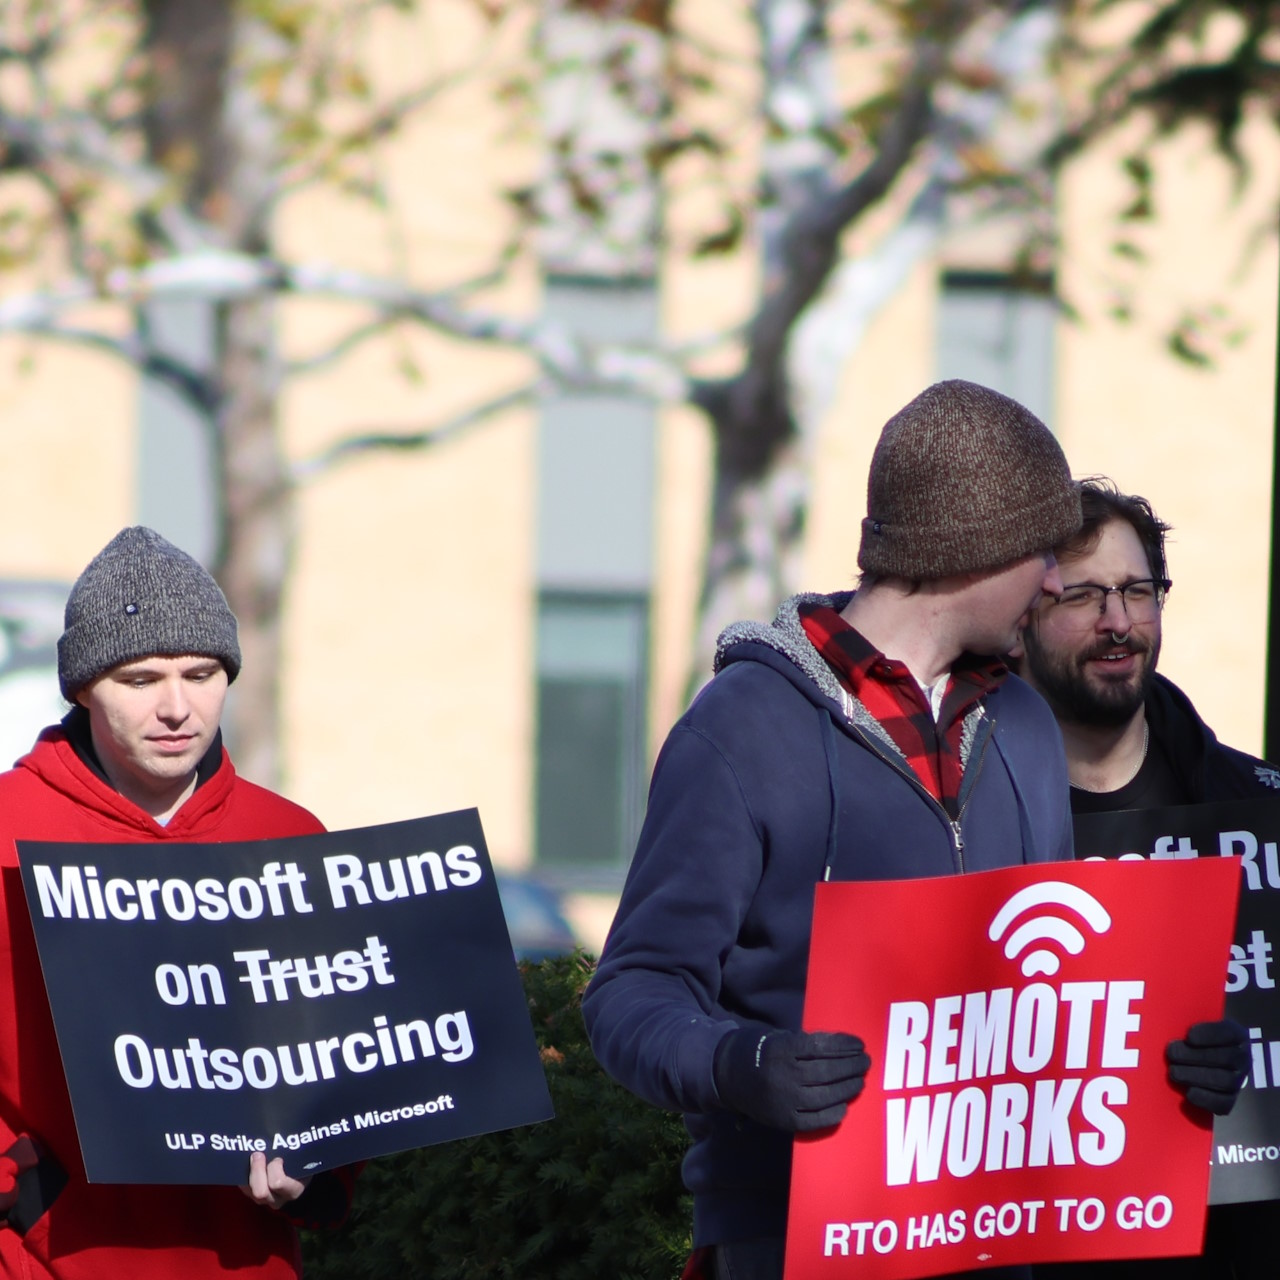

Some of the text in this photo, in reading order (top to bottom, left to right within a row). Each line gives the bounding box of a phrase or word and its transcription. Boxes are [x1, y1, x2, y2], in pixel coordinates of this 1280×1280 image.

[33, 845, 482, 921] Microsoft Runs
[155, 936, 395, 1005] on Trust
[114, 1011, 474, 1090] Outsourcing
[883, 981, 1145, 1091] REMOTE
[165, 1095, 455, 1152] ULP Strike Against Microsoft
[886, 1076, 1129, 1186] WORKS
[824, 1195, 1173, 1256] RTO HAS GOT TO GO
